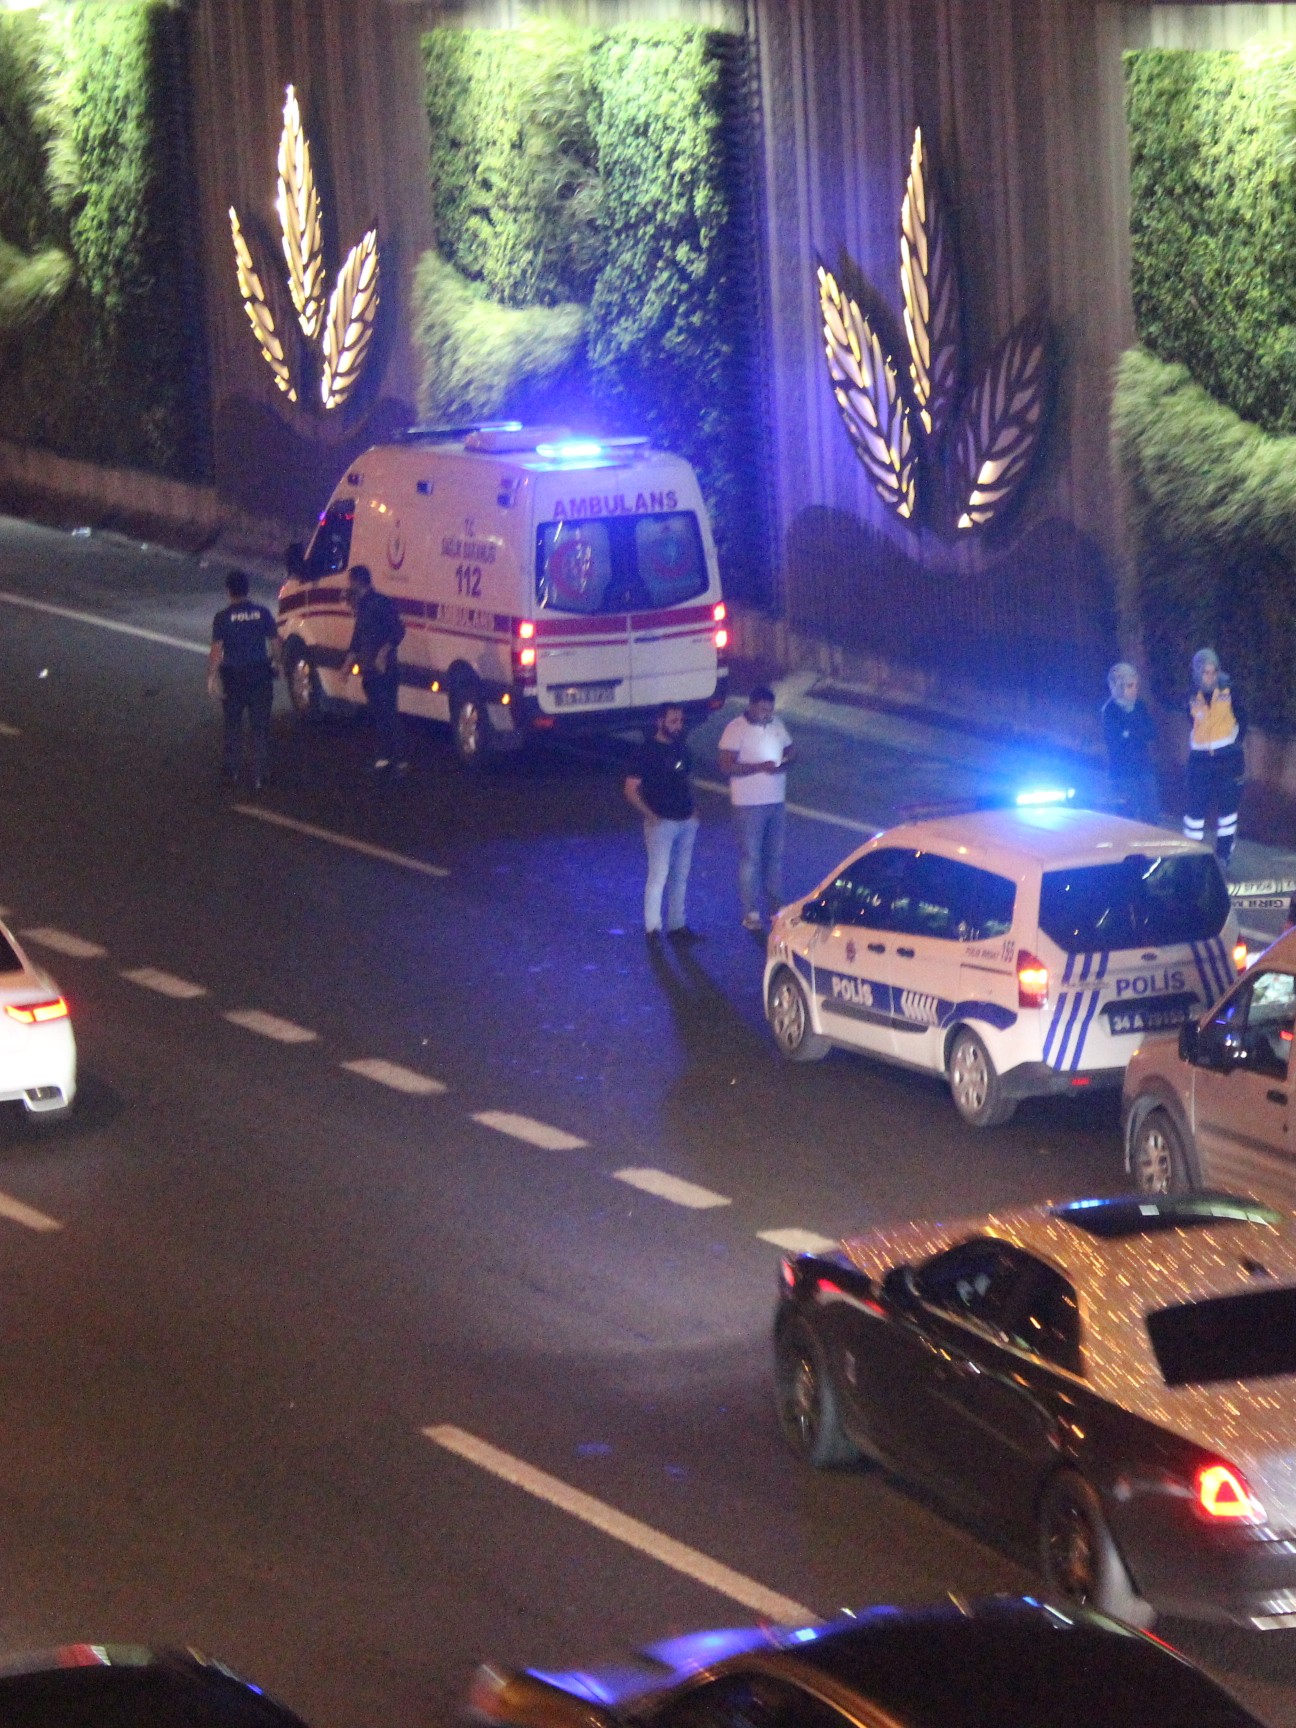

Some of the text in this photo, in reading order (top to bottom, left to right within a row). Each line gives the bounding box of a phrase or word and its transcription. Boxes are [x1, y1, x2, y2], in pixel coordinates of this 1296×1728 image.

[552, 490, 678, 520] AMBULANS
[456, 564, 482, 598] 112
[1112, 1015, 1131, 1031] 34
